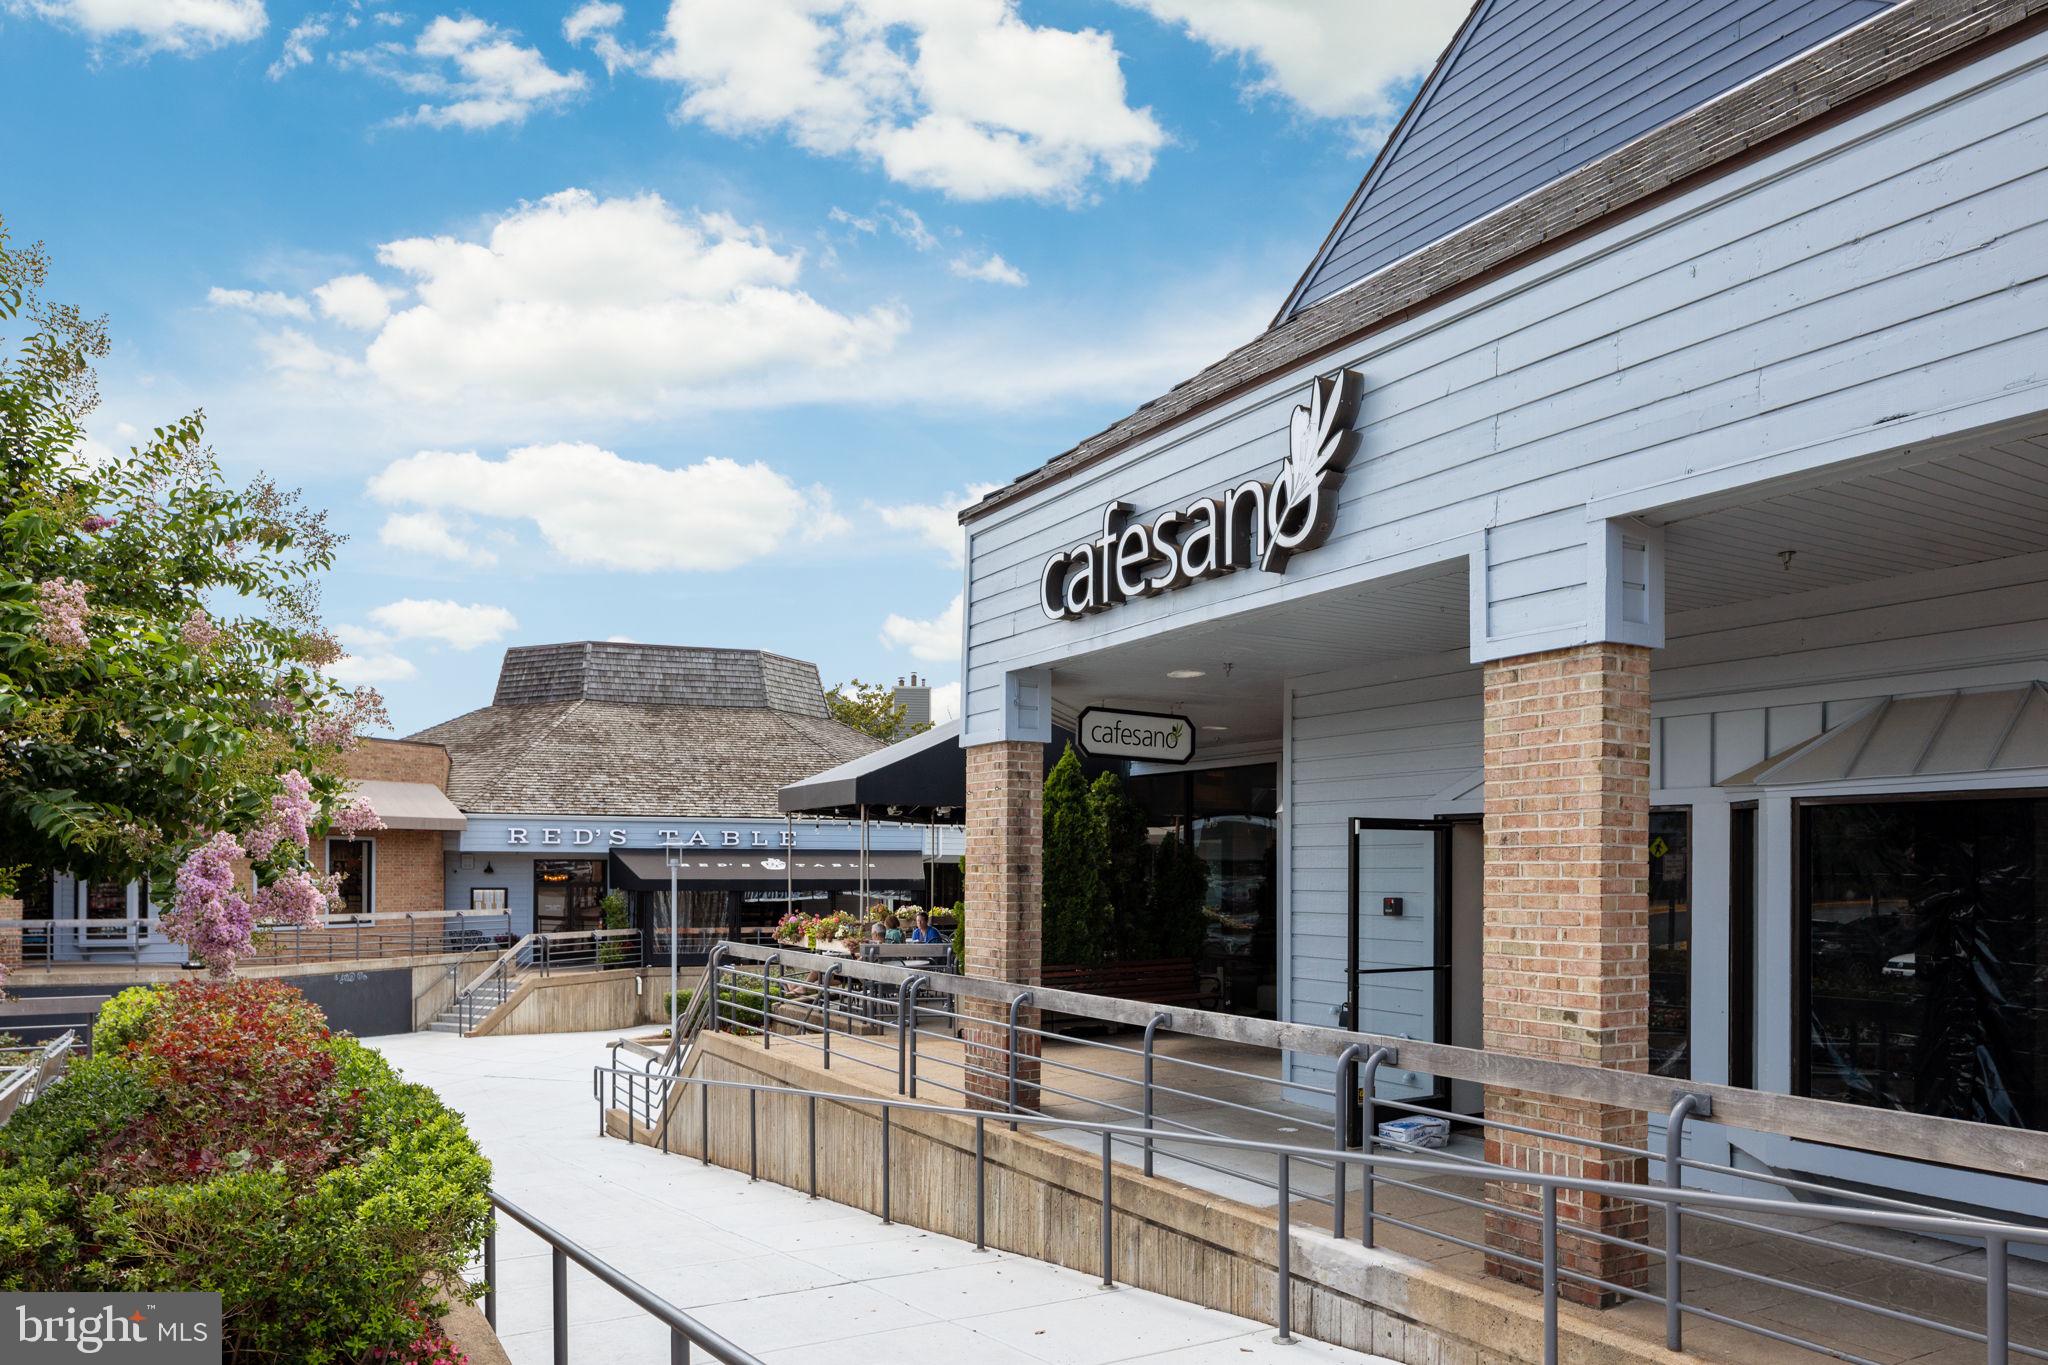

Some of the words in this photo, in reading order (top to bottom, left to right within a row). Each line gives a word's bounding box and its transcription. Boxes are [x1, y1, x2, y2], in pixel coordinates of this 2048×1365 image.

[1040, 455, 1338, 621] cafesano
[1091, 720, 1179, 749] cafesano
[507, 827, 627, 845] RED'S
[658, 829, 797, 846] TABLE
